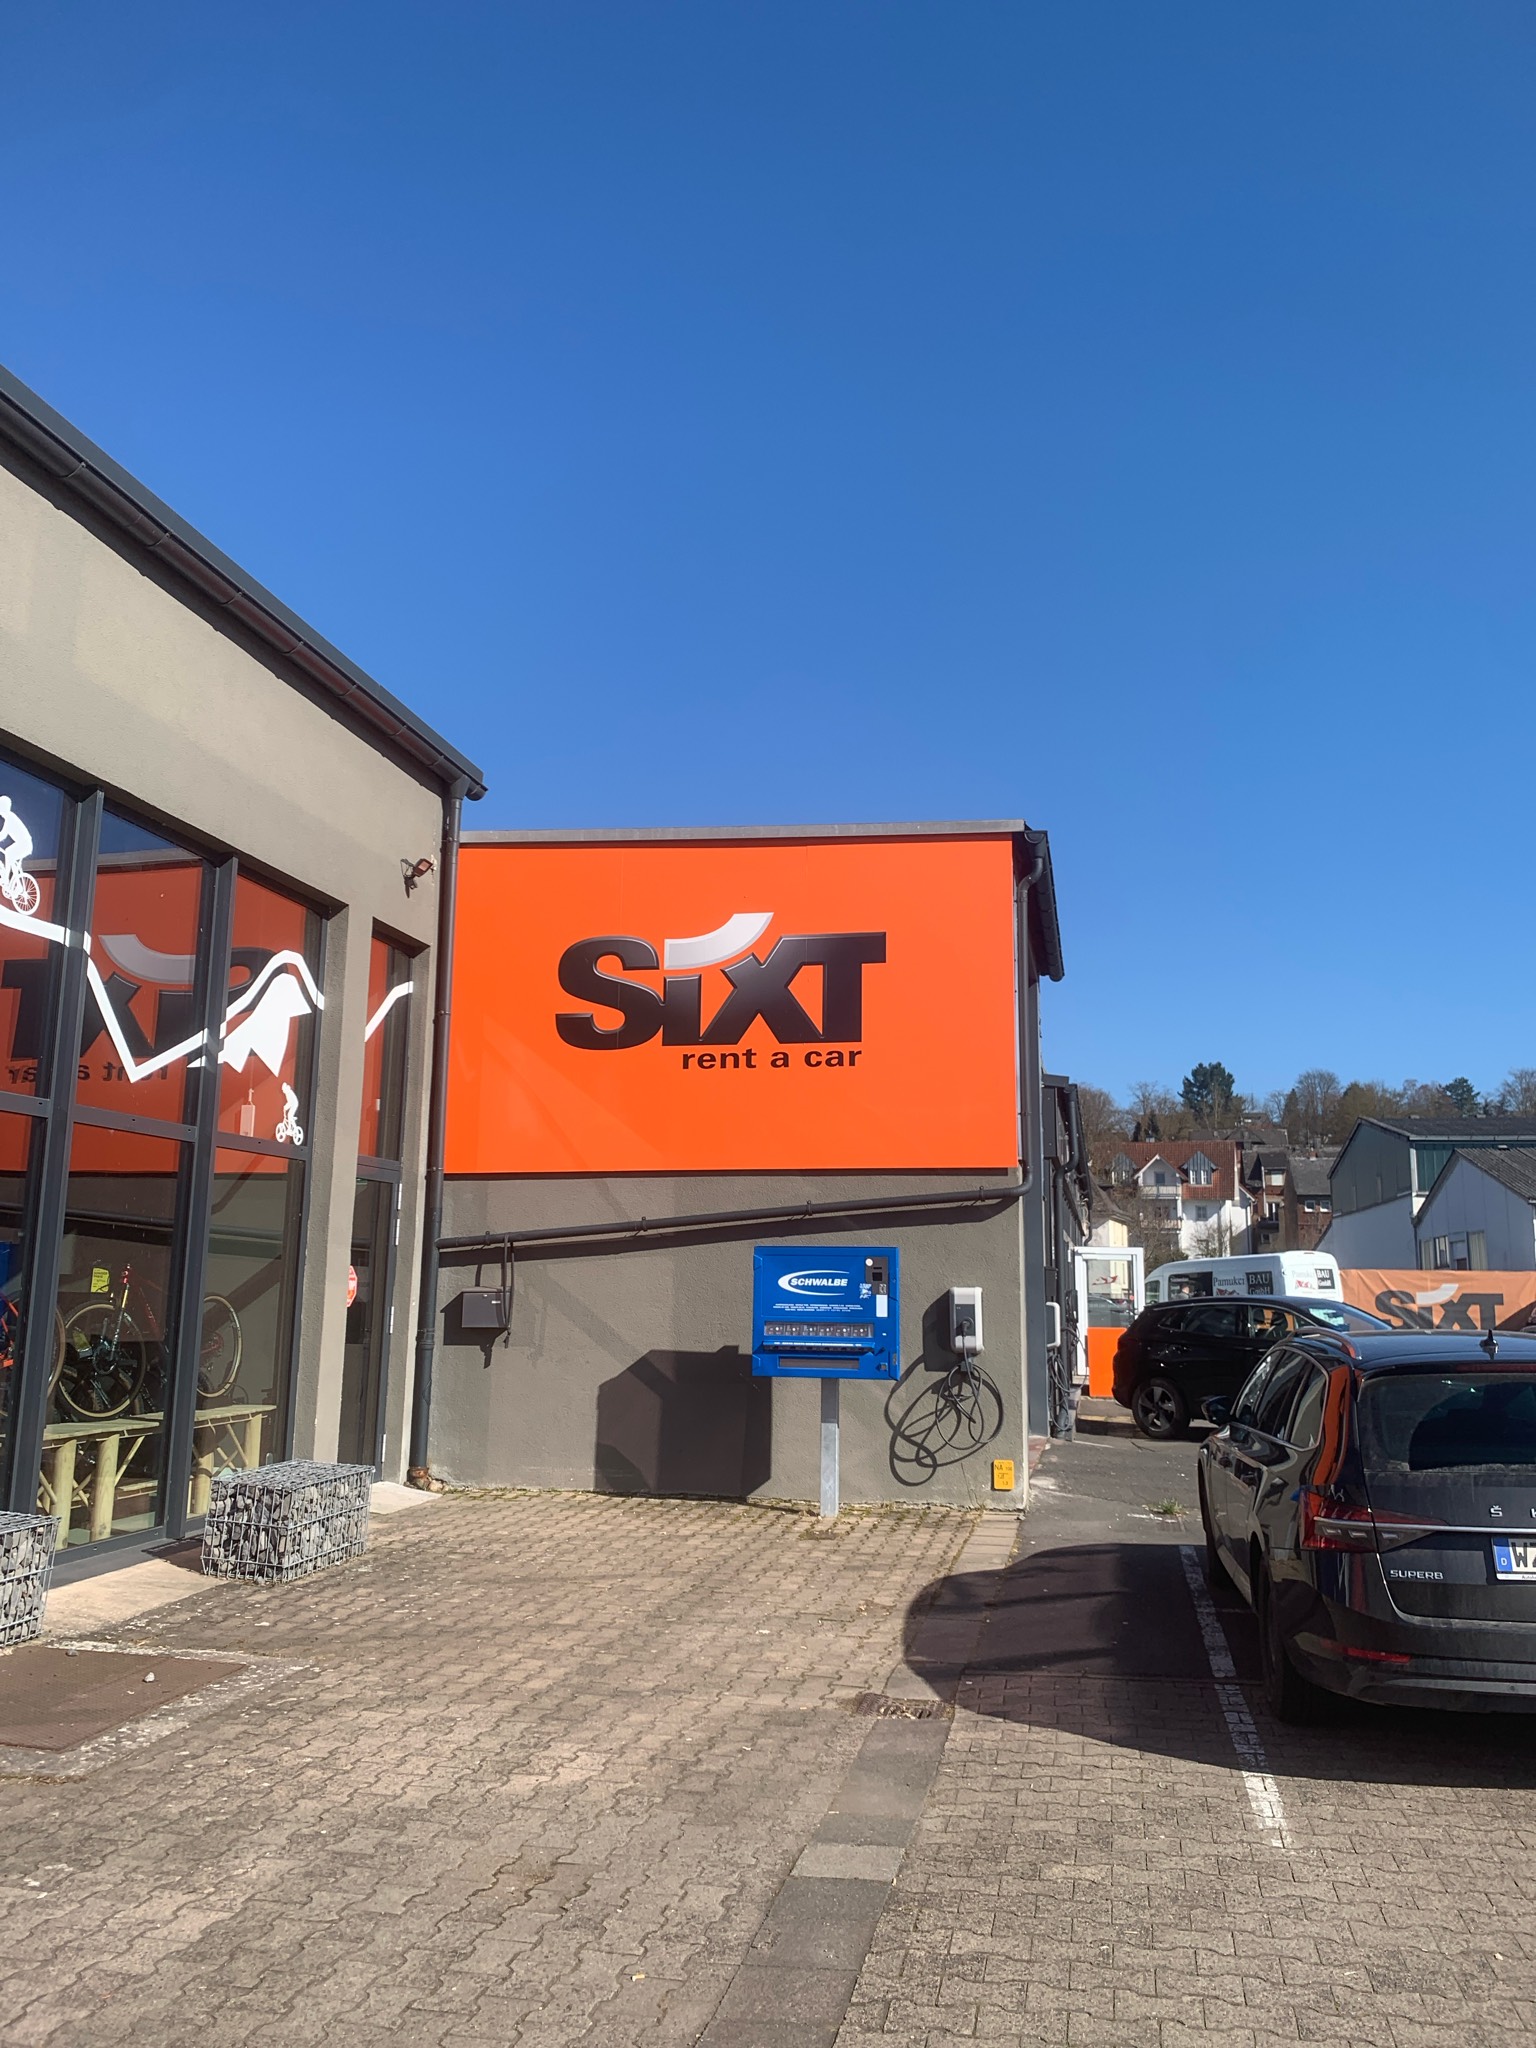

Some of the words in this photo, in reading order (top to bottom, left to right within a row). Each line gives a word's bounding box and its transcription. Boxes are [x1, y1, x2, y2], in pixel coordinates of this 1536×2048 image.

[682, 1048, 757, 1069] rent
[770, 1050, 790, 1068] a
[803, 1048, 862, 1067] car
[1249, 1273, 1270, 1285] BAU
[1316, 1269, 1330, 1279] BAU
[790, 1278, 848, 1287] SCHWALBE
[1390, 1570, 1444, 1580] SUPERB
